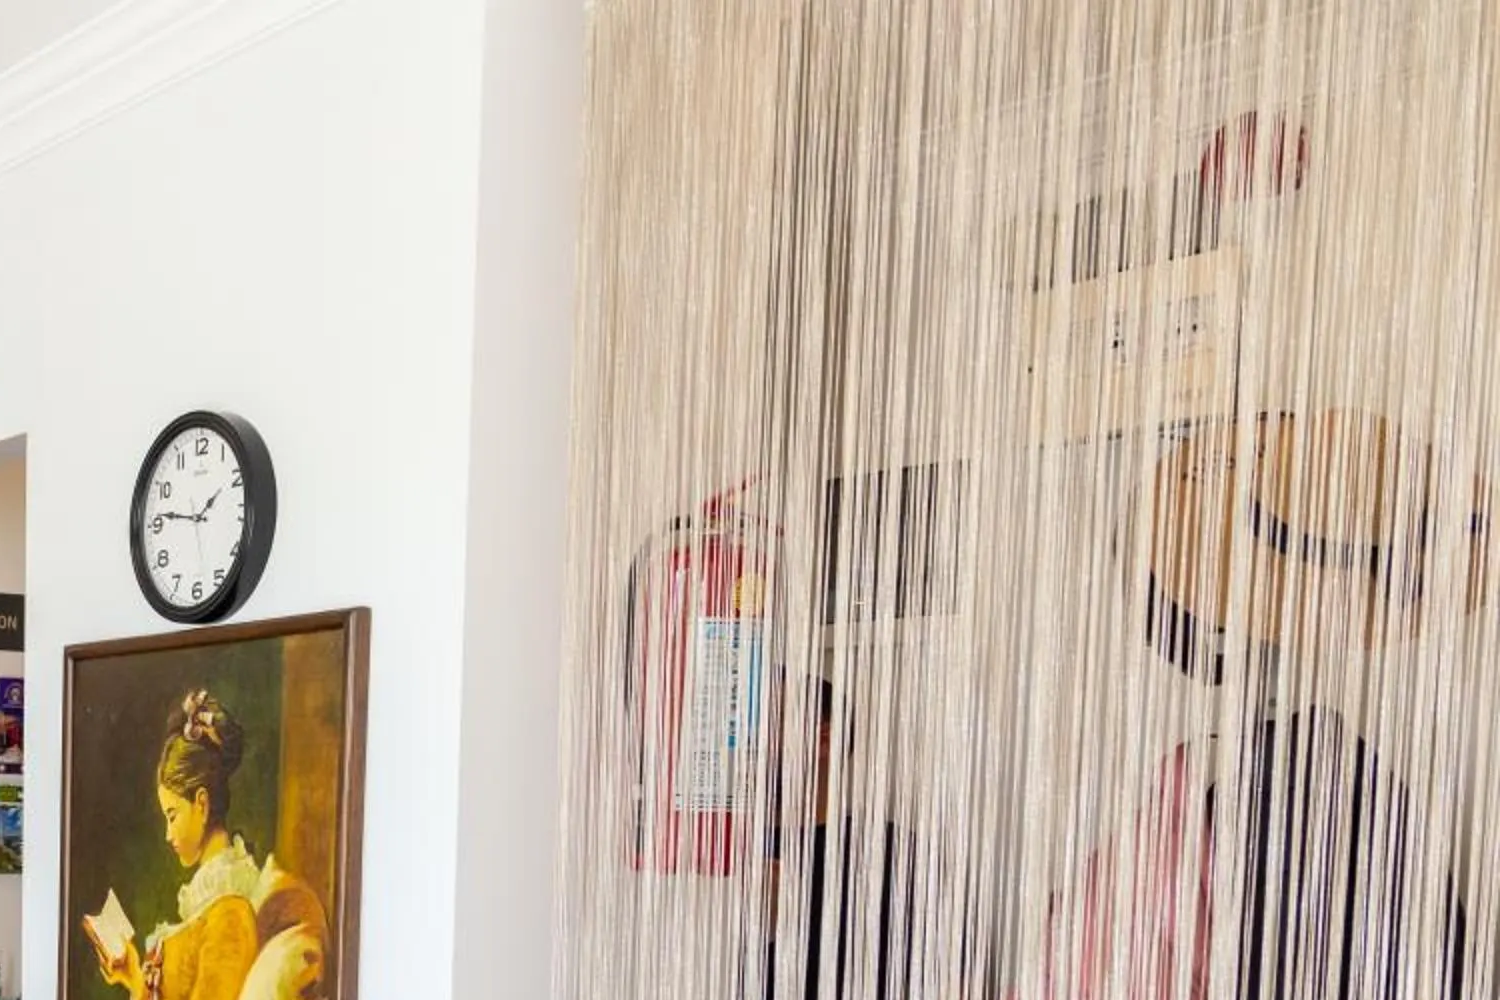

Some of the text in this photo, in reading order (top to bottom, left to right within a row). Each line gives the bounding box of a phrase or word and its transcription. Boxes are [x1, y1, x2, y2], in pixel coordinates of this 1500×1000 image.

[195, 437, 208, 456] 12
[177, 452, 185, 470] 11
[232, 469, 243, 488] 2
[160, 481, 171, 500] 10
[153, 517, 163, 534] 9
[157, 549, 169, 568] 8
[172, 574, 181, 593] 7
[213, 569, 225, 587] 5
[192, 581, 202, 600] 6
